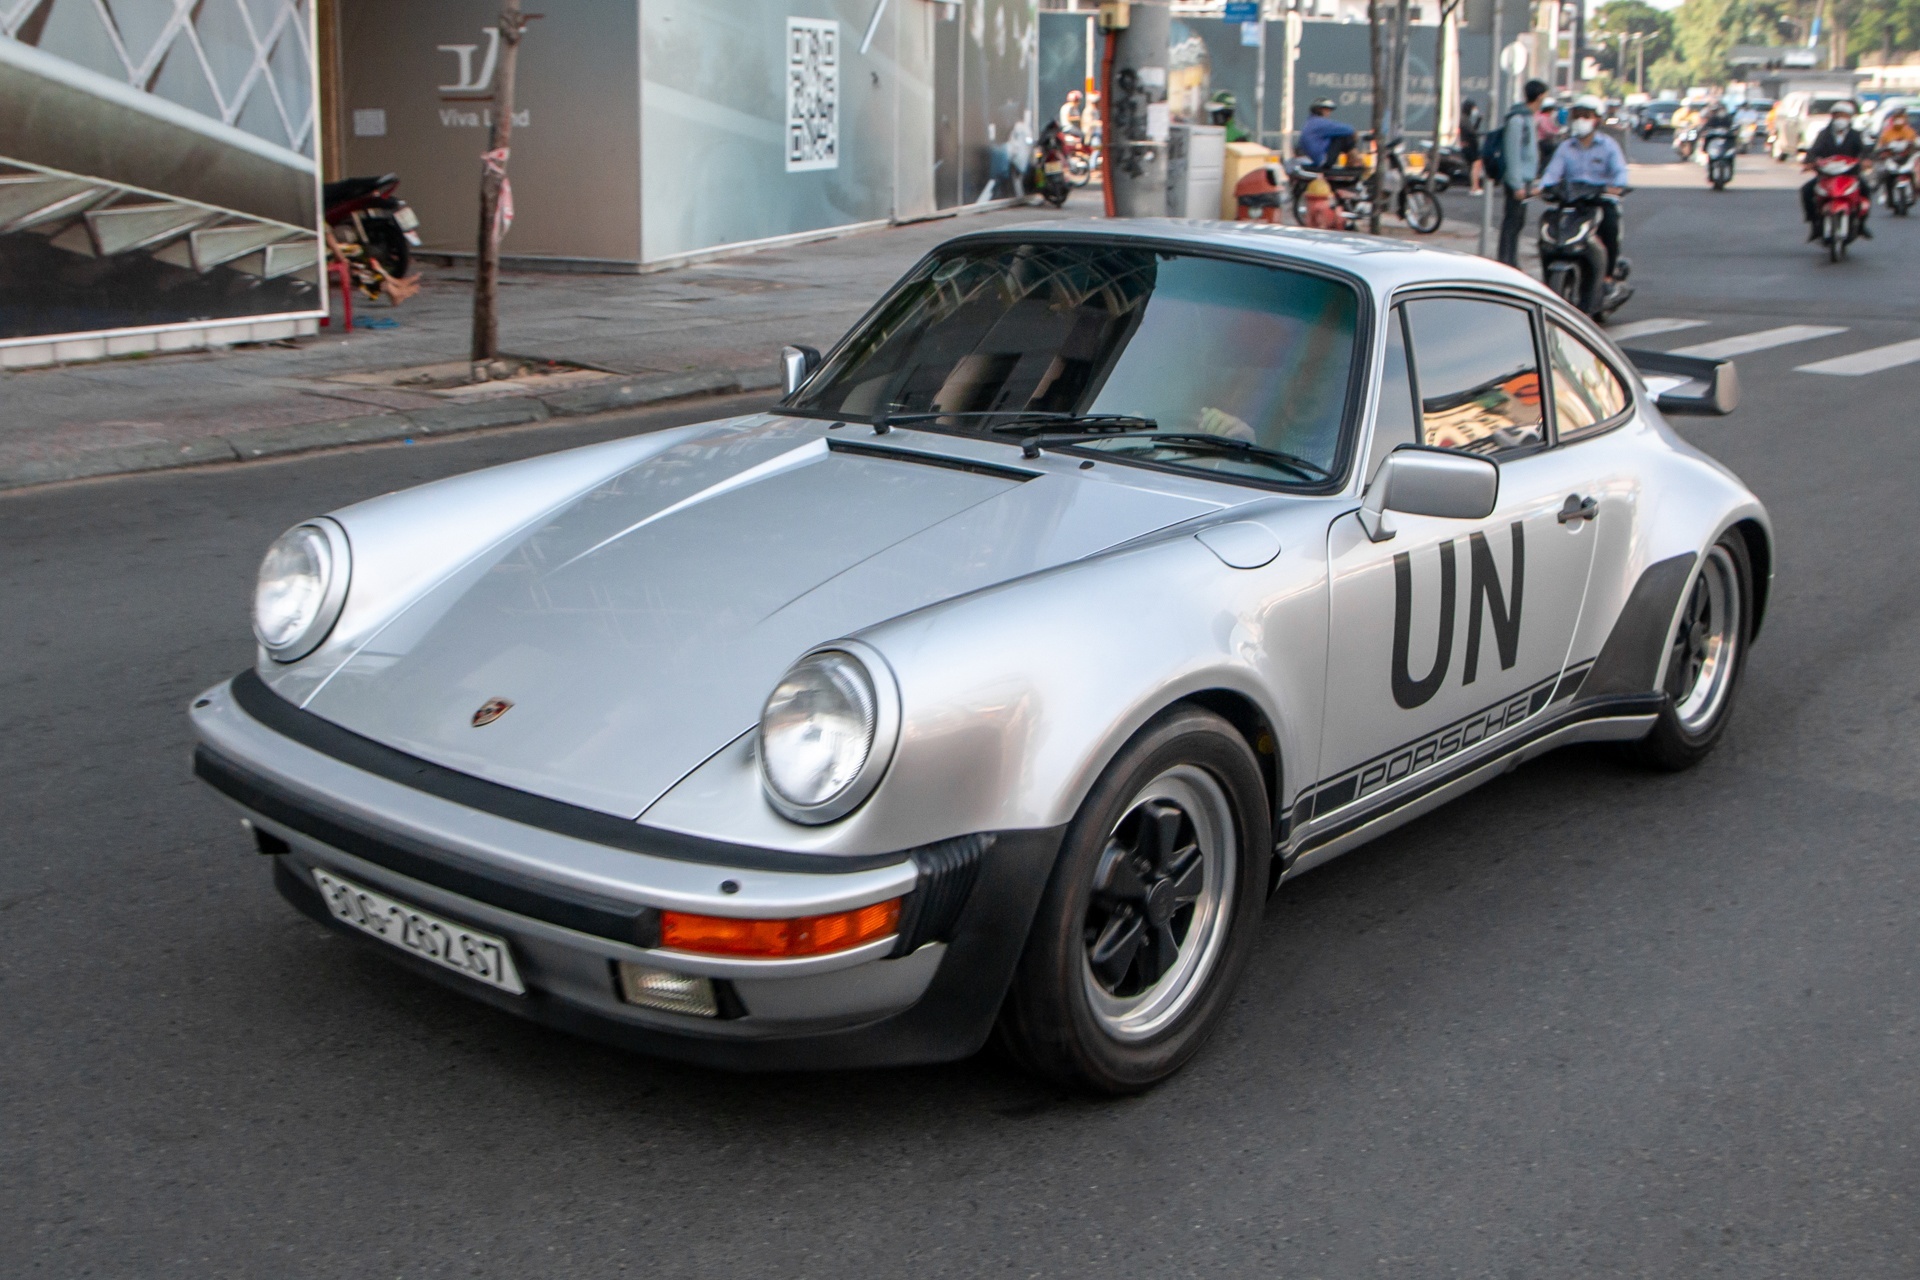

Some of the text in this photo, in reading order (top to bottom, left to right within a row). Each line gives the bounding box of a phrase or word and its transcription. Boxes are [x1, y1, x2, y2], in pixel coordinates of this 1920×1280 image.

[438, 108, 530, 127] Viva Lnd
[1391, 521, 1524, 709] UN
[1357, 694, 1530, 797] PORSCHE
